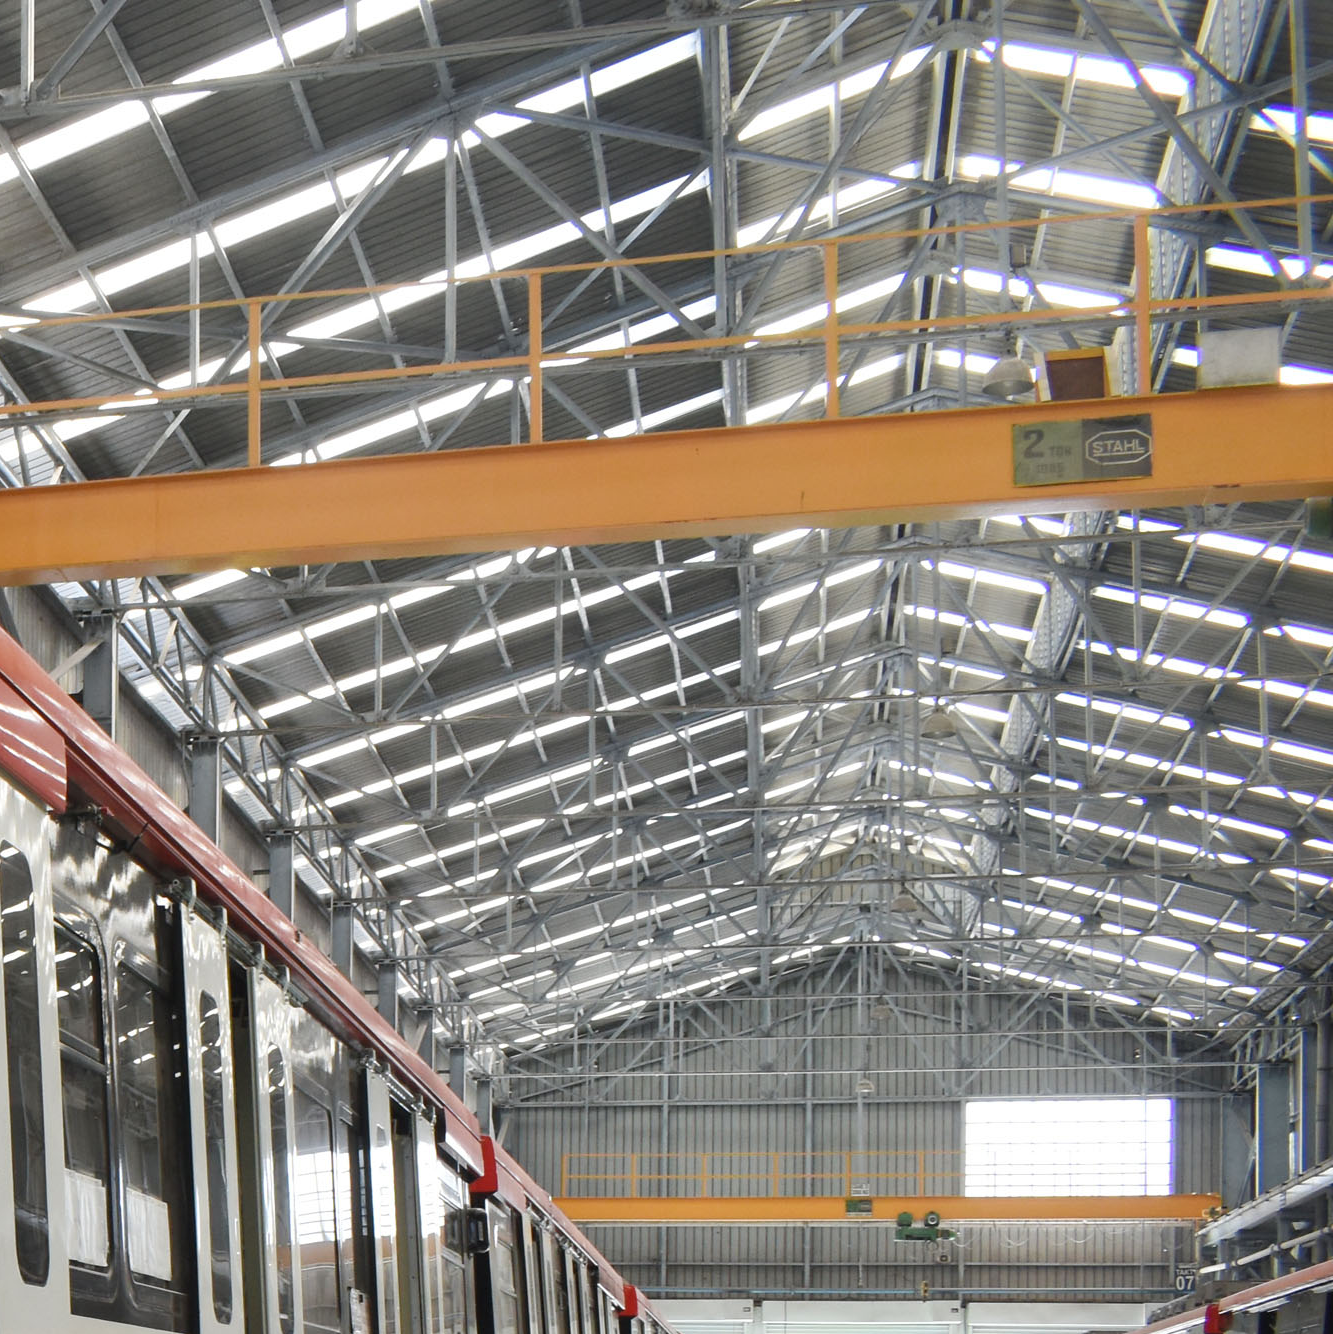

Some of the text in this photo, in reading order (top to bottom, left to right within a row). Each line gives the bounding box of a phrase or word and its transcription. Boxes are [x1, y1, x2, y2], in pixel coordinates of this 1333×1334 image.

[1023, 429, 1044, 459] 2
[1092, 438, 1145, 454] STAHL
[1176, 1276, 1194, 1290] 07
